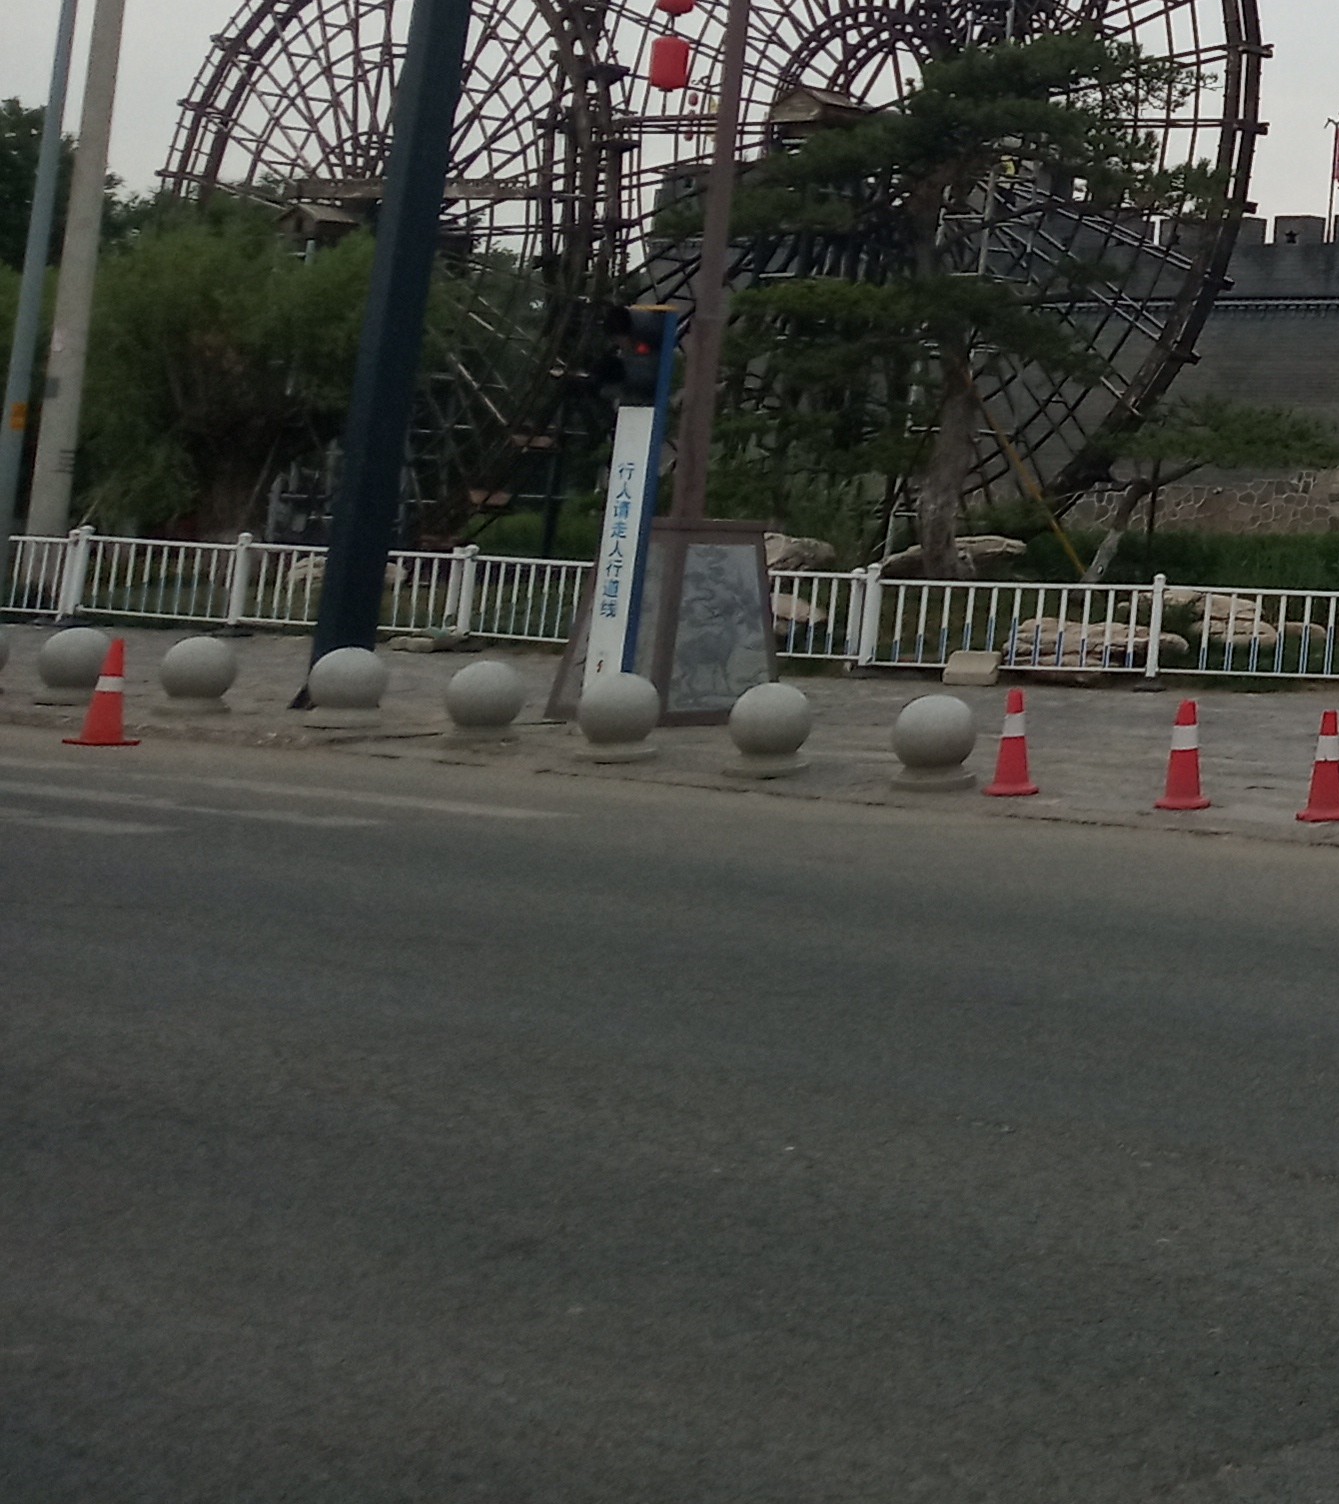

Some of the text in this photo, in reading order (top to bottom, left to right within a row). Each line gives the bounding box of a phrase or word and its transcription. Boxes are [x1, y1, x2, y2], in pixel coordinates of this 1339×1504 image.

[599, 462, 635, 618] 行人请走人行道线
